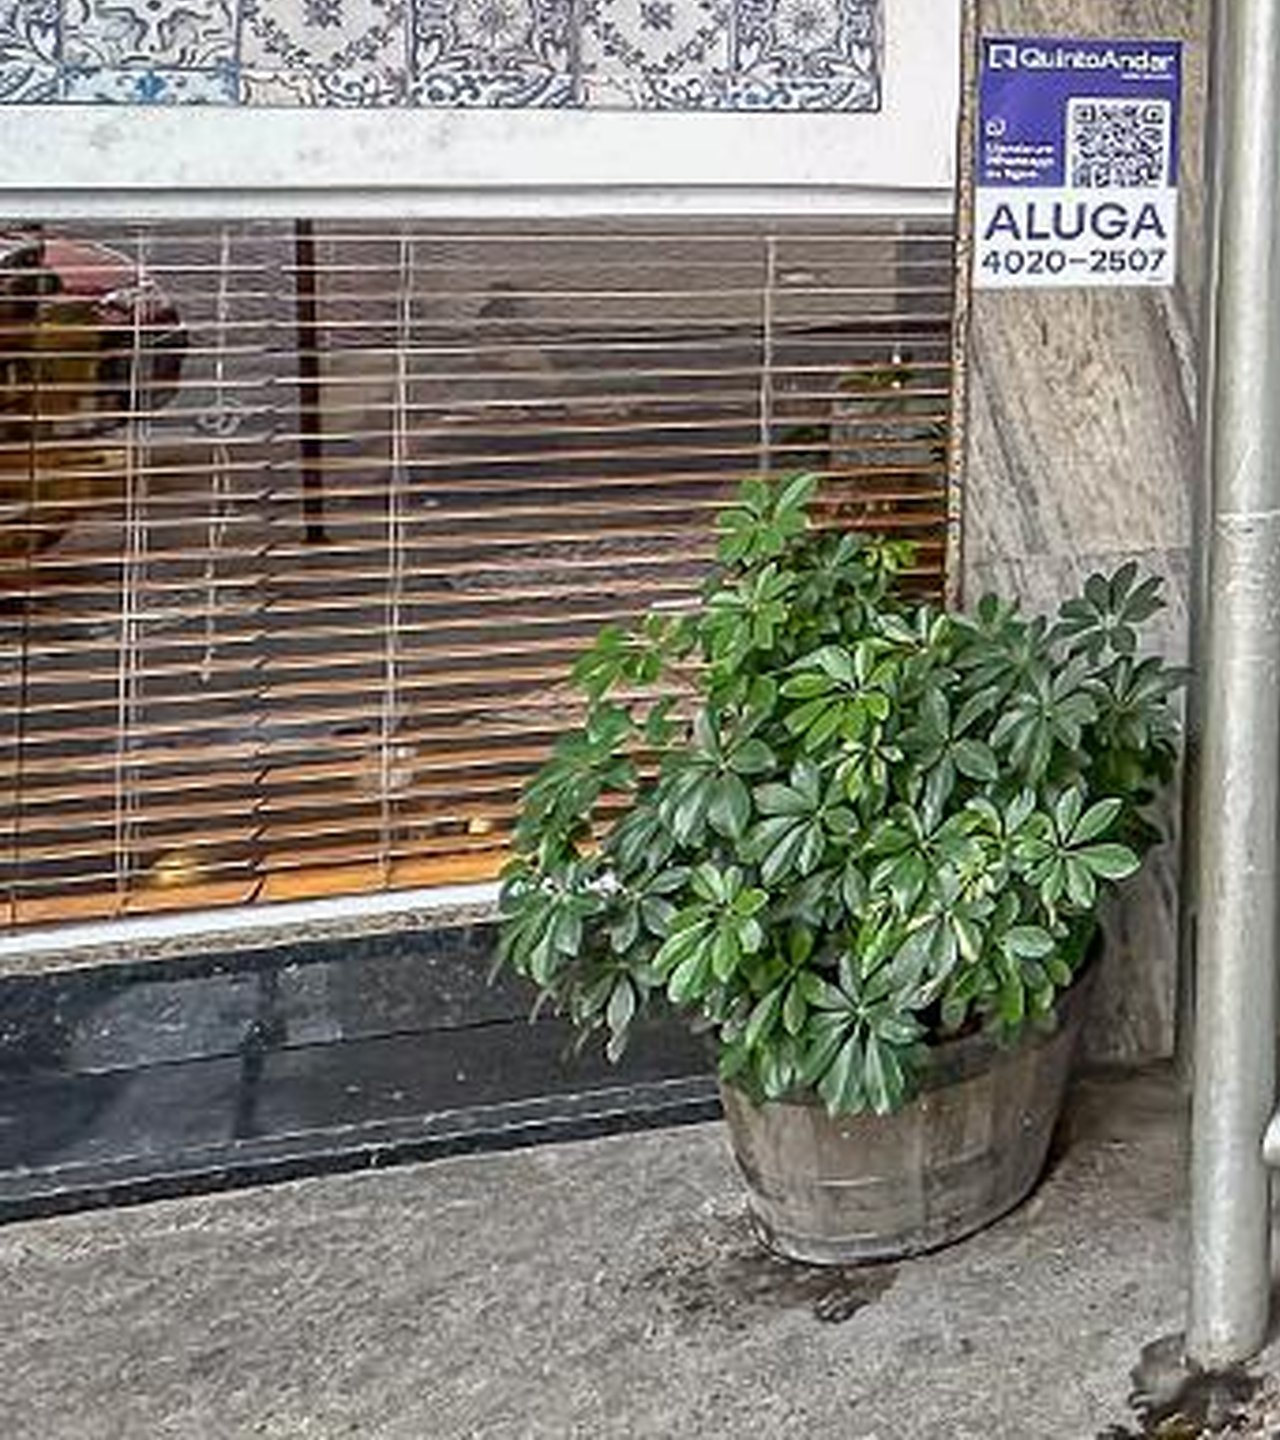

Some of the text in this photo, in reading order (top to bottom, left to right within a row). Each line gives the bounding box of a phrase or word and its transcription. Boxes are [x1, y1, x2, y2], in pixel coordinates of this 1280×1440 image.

[1018, 46, 1175, 71] QuintoAndar
[984, 202, 1167, 241] ALUGA
[981, 248, 1167, 275] 4020-2507
